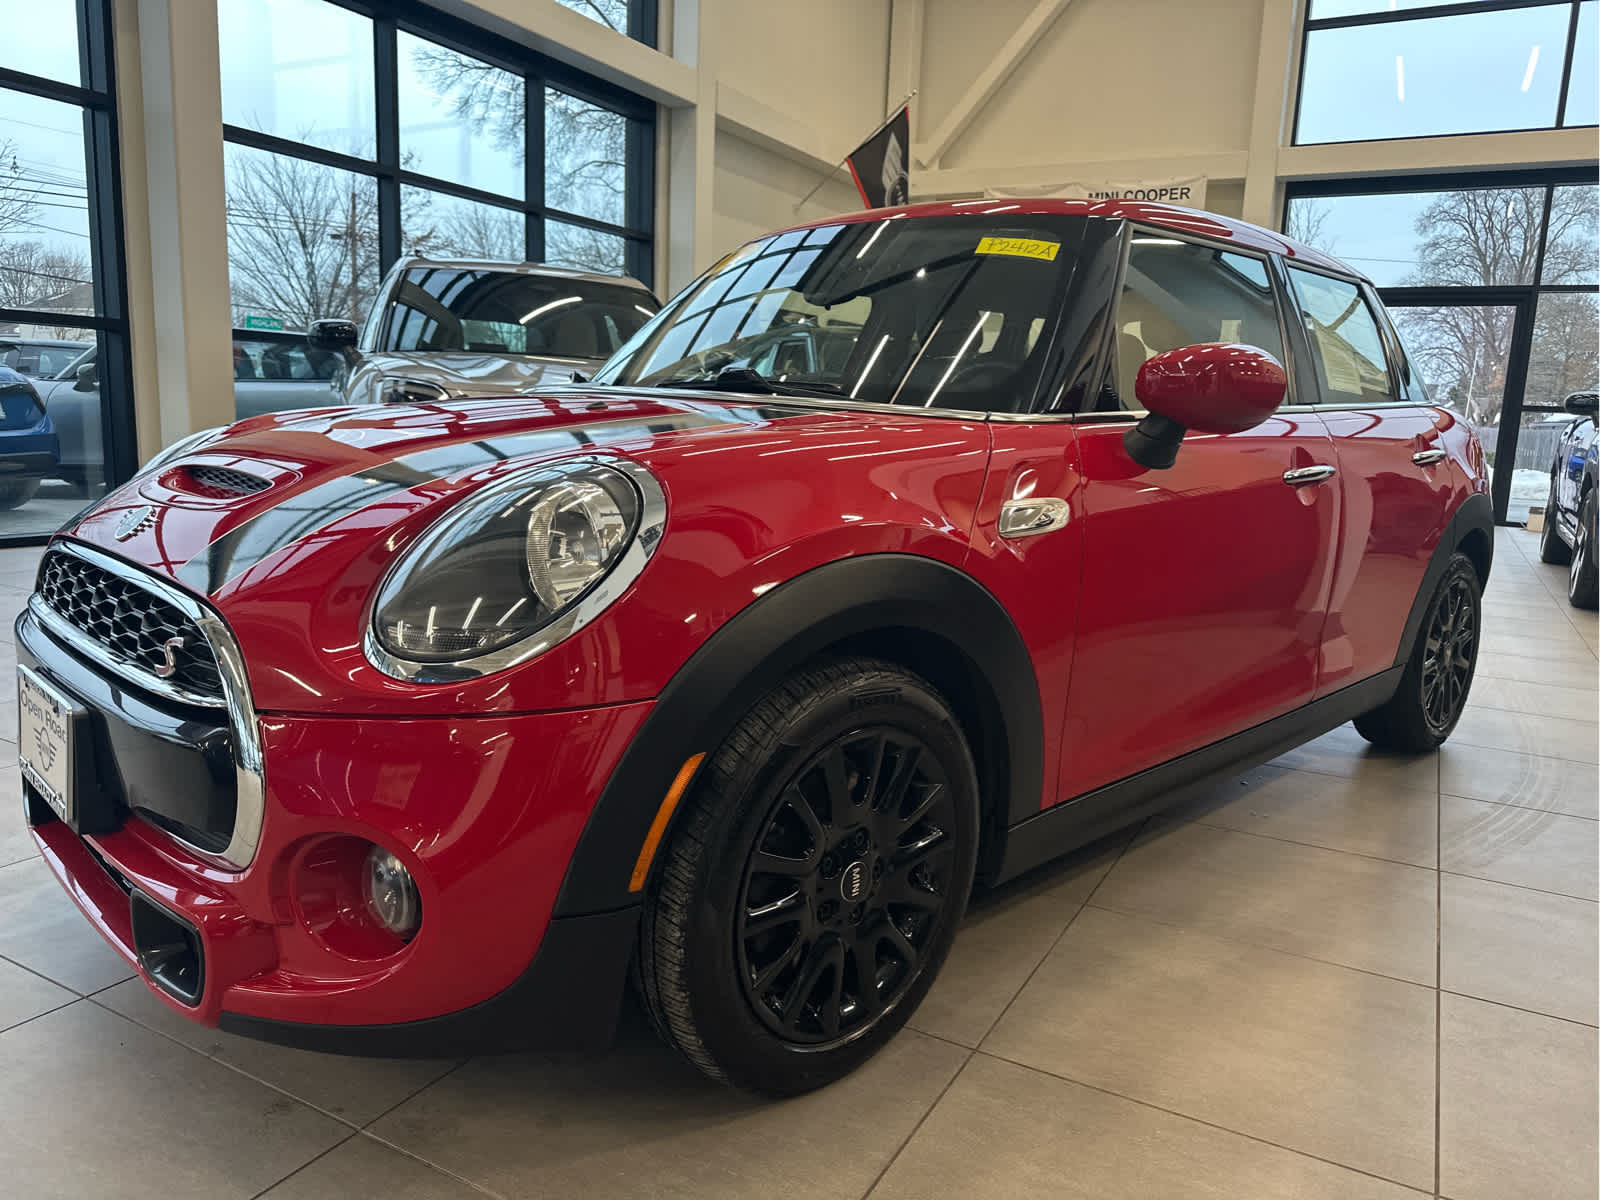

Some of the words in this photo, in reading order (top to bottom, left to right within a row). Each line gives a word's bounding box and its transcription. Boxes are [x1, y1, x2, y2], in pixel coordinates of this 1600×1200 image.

[1124, 187, 1191, 201] COOPER
[20, 689, 43, 721] Open
[851, 867, 861, 897] MINI
